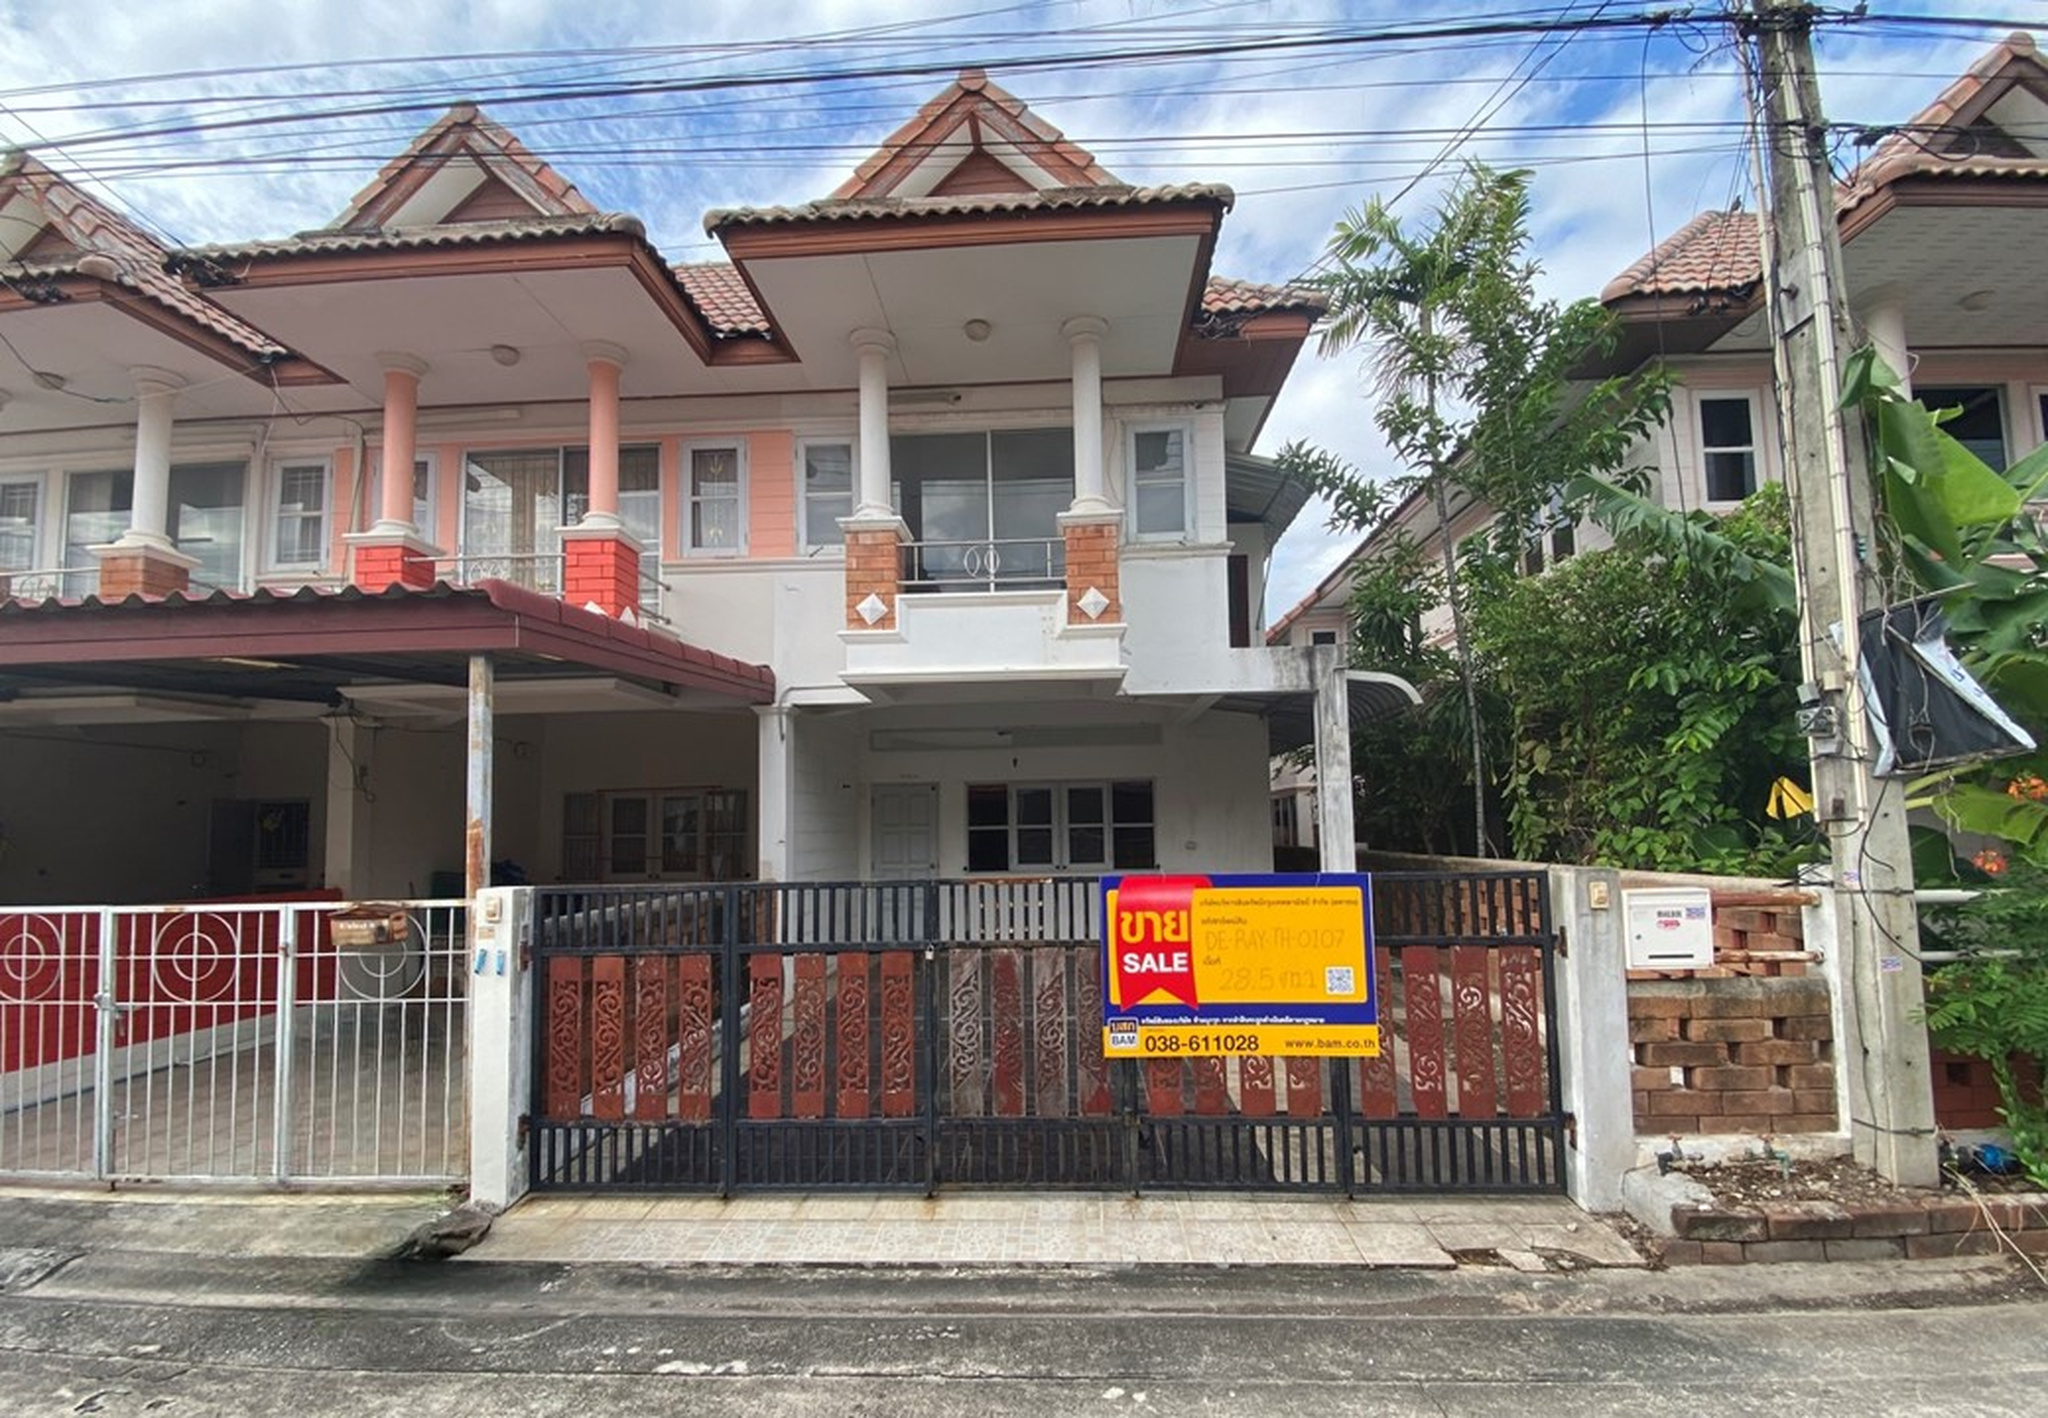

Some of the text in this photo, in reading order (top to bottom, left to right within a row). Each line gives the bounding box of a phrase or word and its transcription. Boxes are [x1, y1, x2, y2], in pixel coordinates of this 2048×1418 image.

[1121, 911, 1188, 944] ขาย
[1123, 953, 1188, 973] SALE
[1111, 1034, 1136, 1047] BAM
[1145, 1035, 1259, 1052] 038-611028
[1285, 1039, 1376, 1049] www.bam.co.th
